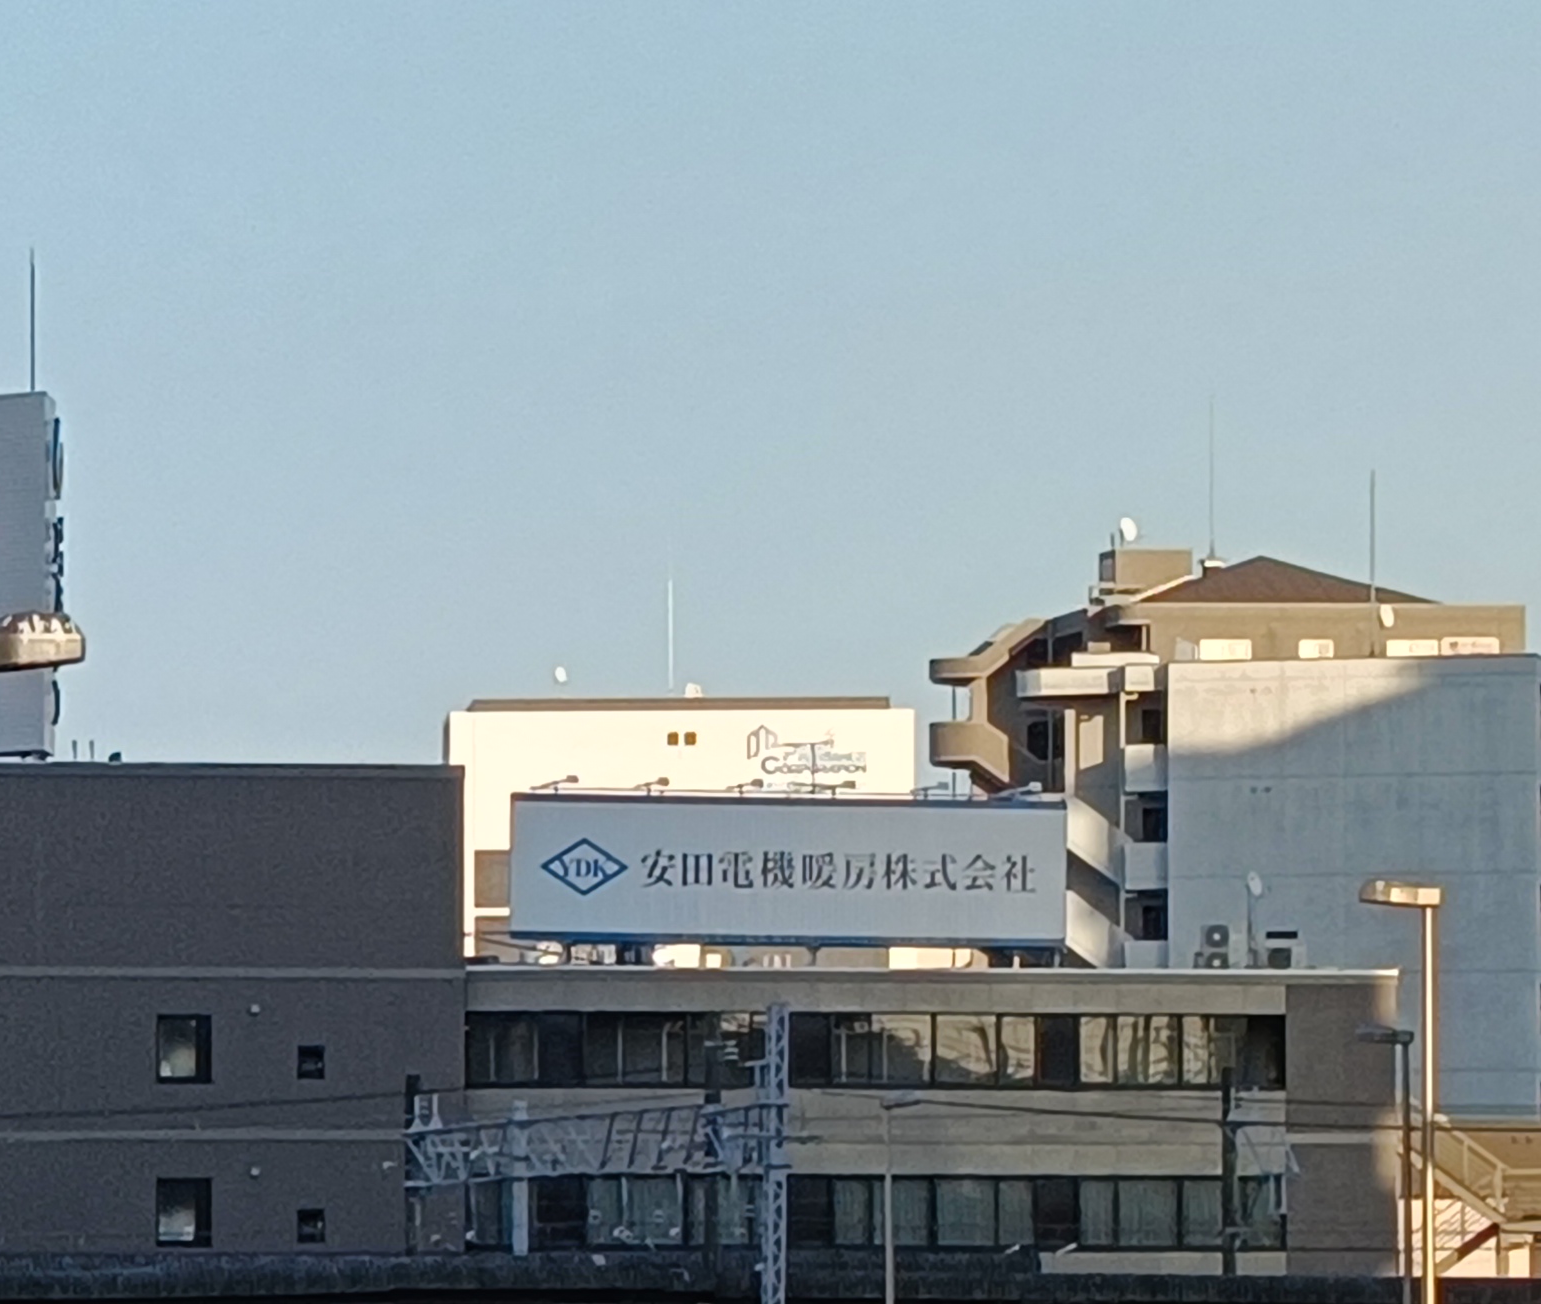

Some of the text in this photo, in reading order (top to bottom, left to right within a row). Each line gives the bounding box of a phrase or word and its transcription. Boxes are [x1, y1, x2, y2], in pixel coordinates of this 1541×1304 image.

[641, 848, 1037, 893] 安田電機暖房株式会社
